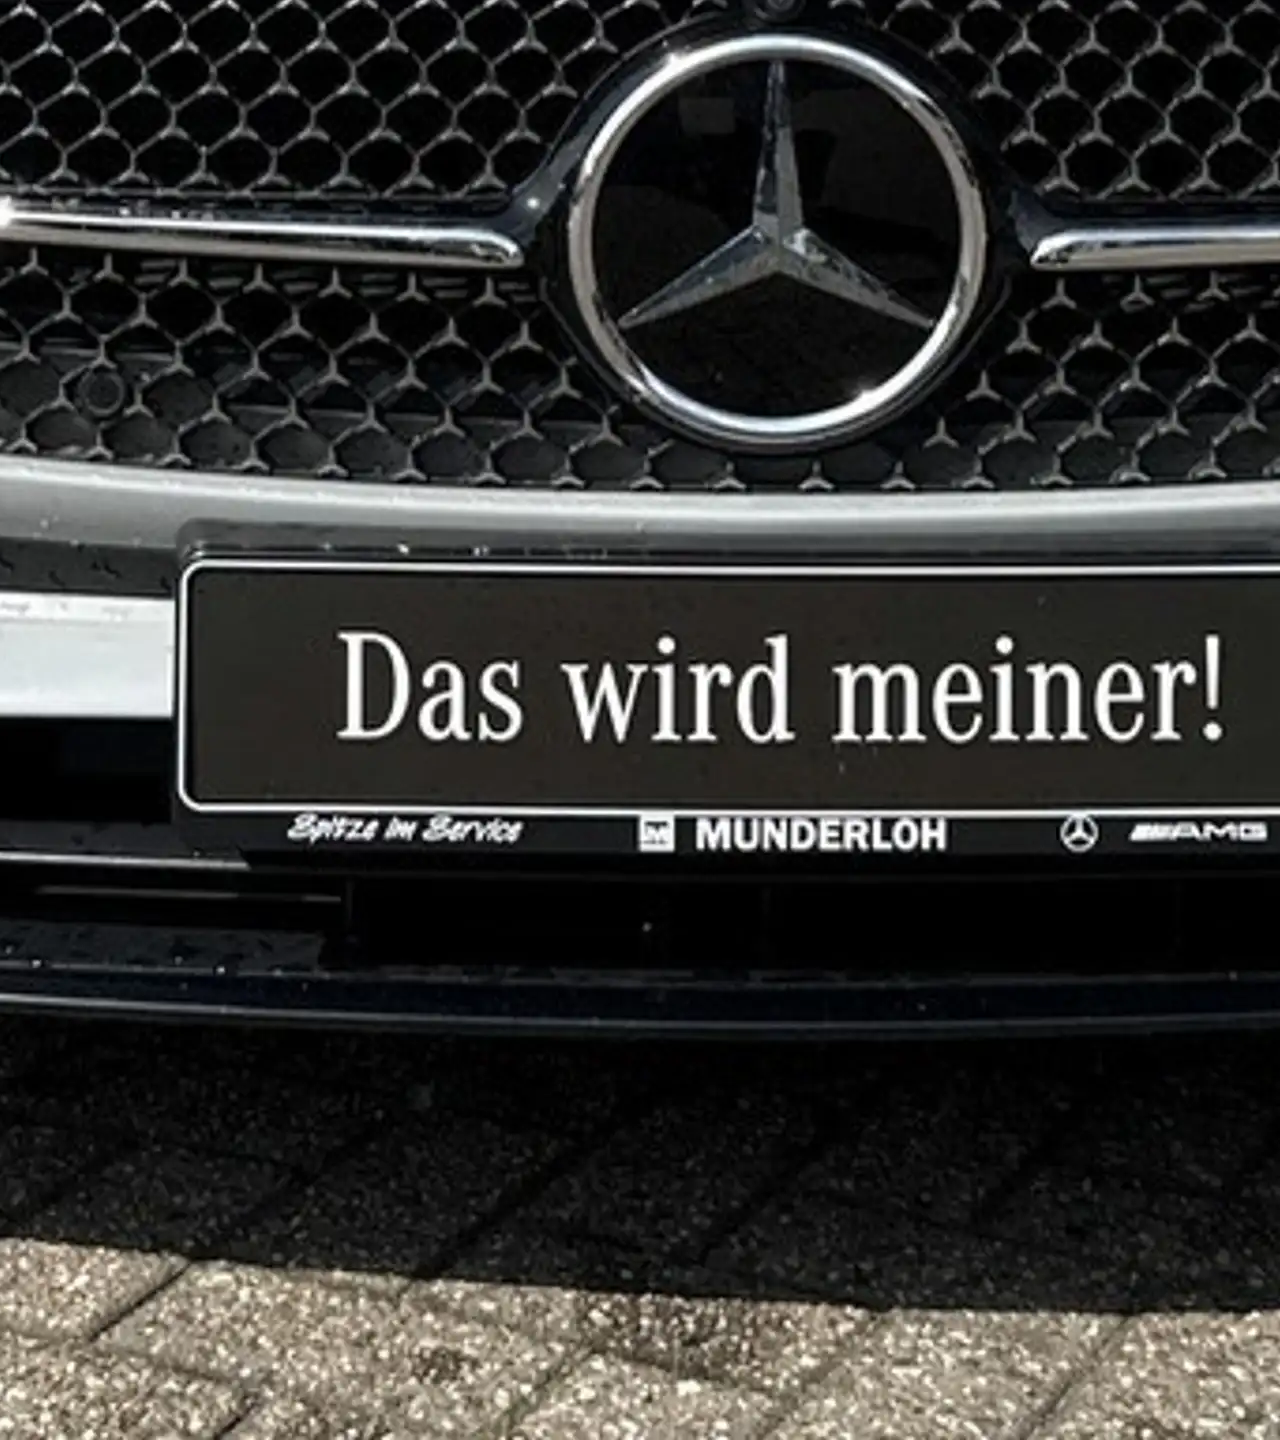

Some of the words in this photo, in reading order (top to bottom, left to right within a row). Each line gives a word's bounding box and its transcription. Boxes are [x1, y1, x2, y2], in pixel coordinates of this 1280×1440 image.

[336, 631, 523, 742] Das
[560, 634, 795, 743] wird
[831, 634, 1223, 744] meiner!
[286, 813, 380, 844] Spitze
[422, 813, 524, 844] Service
[695, 817, 947, 851] MUNDERLOH
